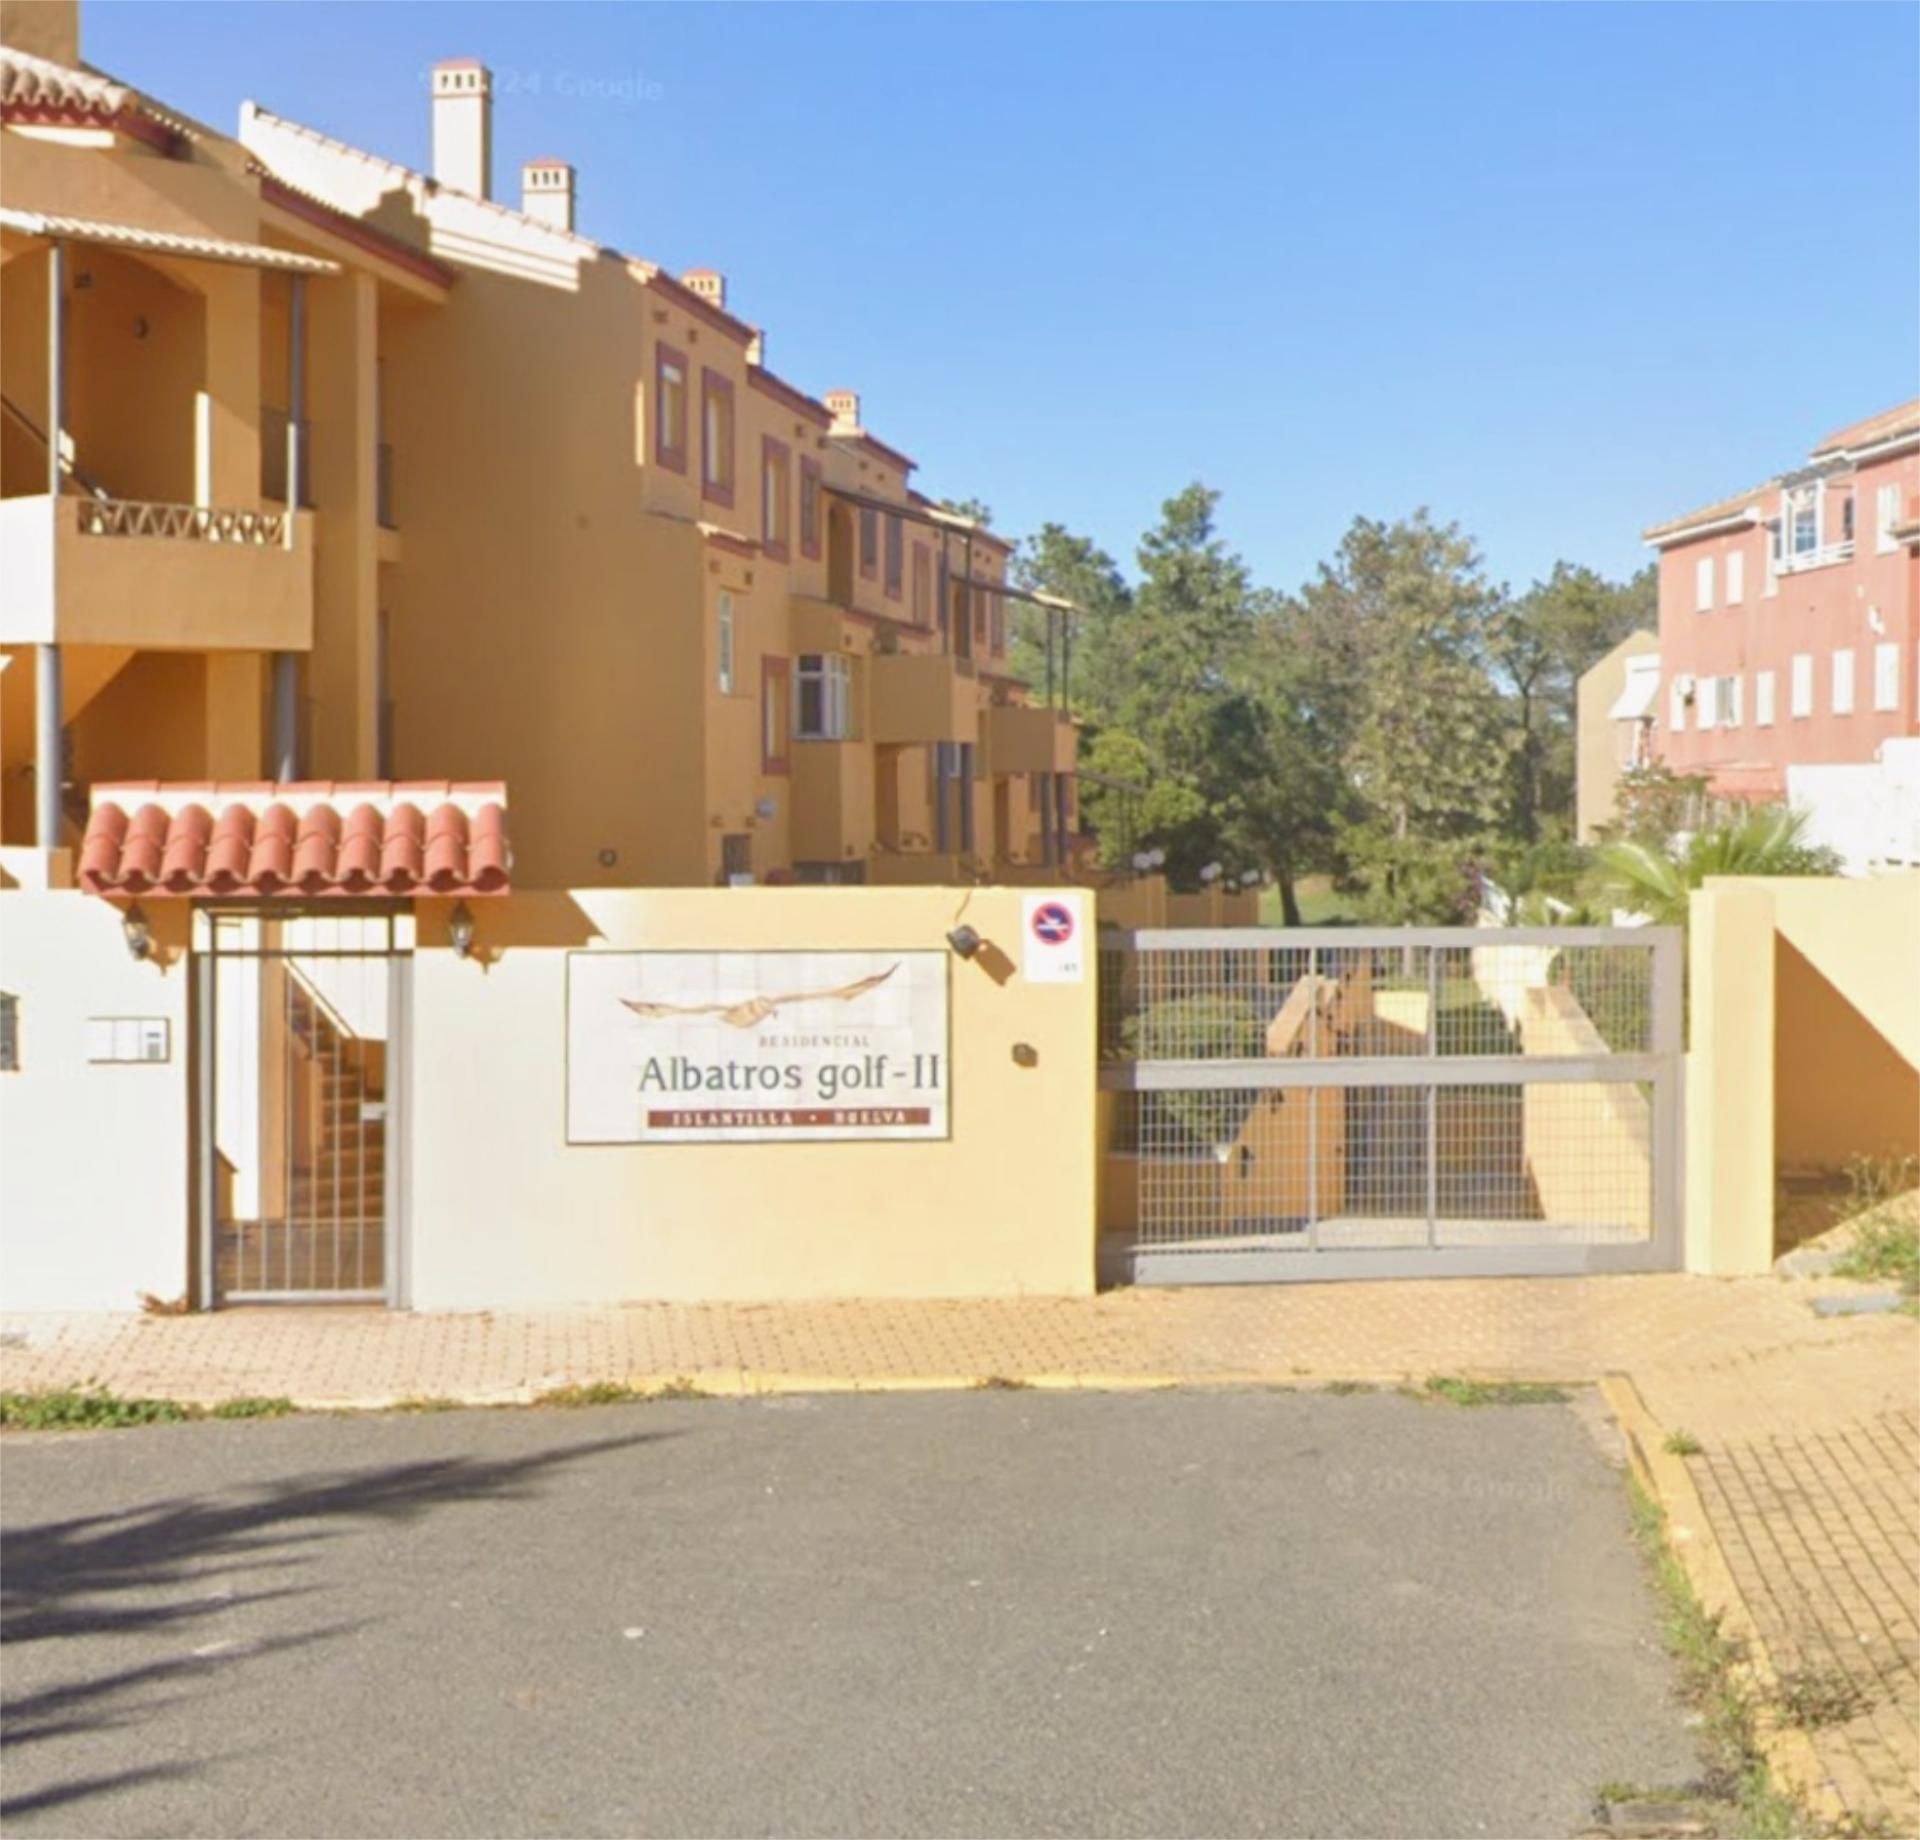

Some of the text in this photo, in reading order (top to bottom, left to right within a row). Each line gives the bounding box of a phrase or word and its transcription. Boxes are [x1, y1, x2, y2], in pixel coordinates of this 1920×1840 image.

[759, 1034, 871, 1048] RESIDENCIAL
[638, 1055, 803, 1092] Albatros
[672, 1109, 907, 1126] ISLANTILLA HUELVA
